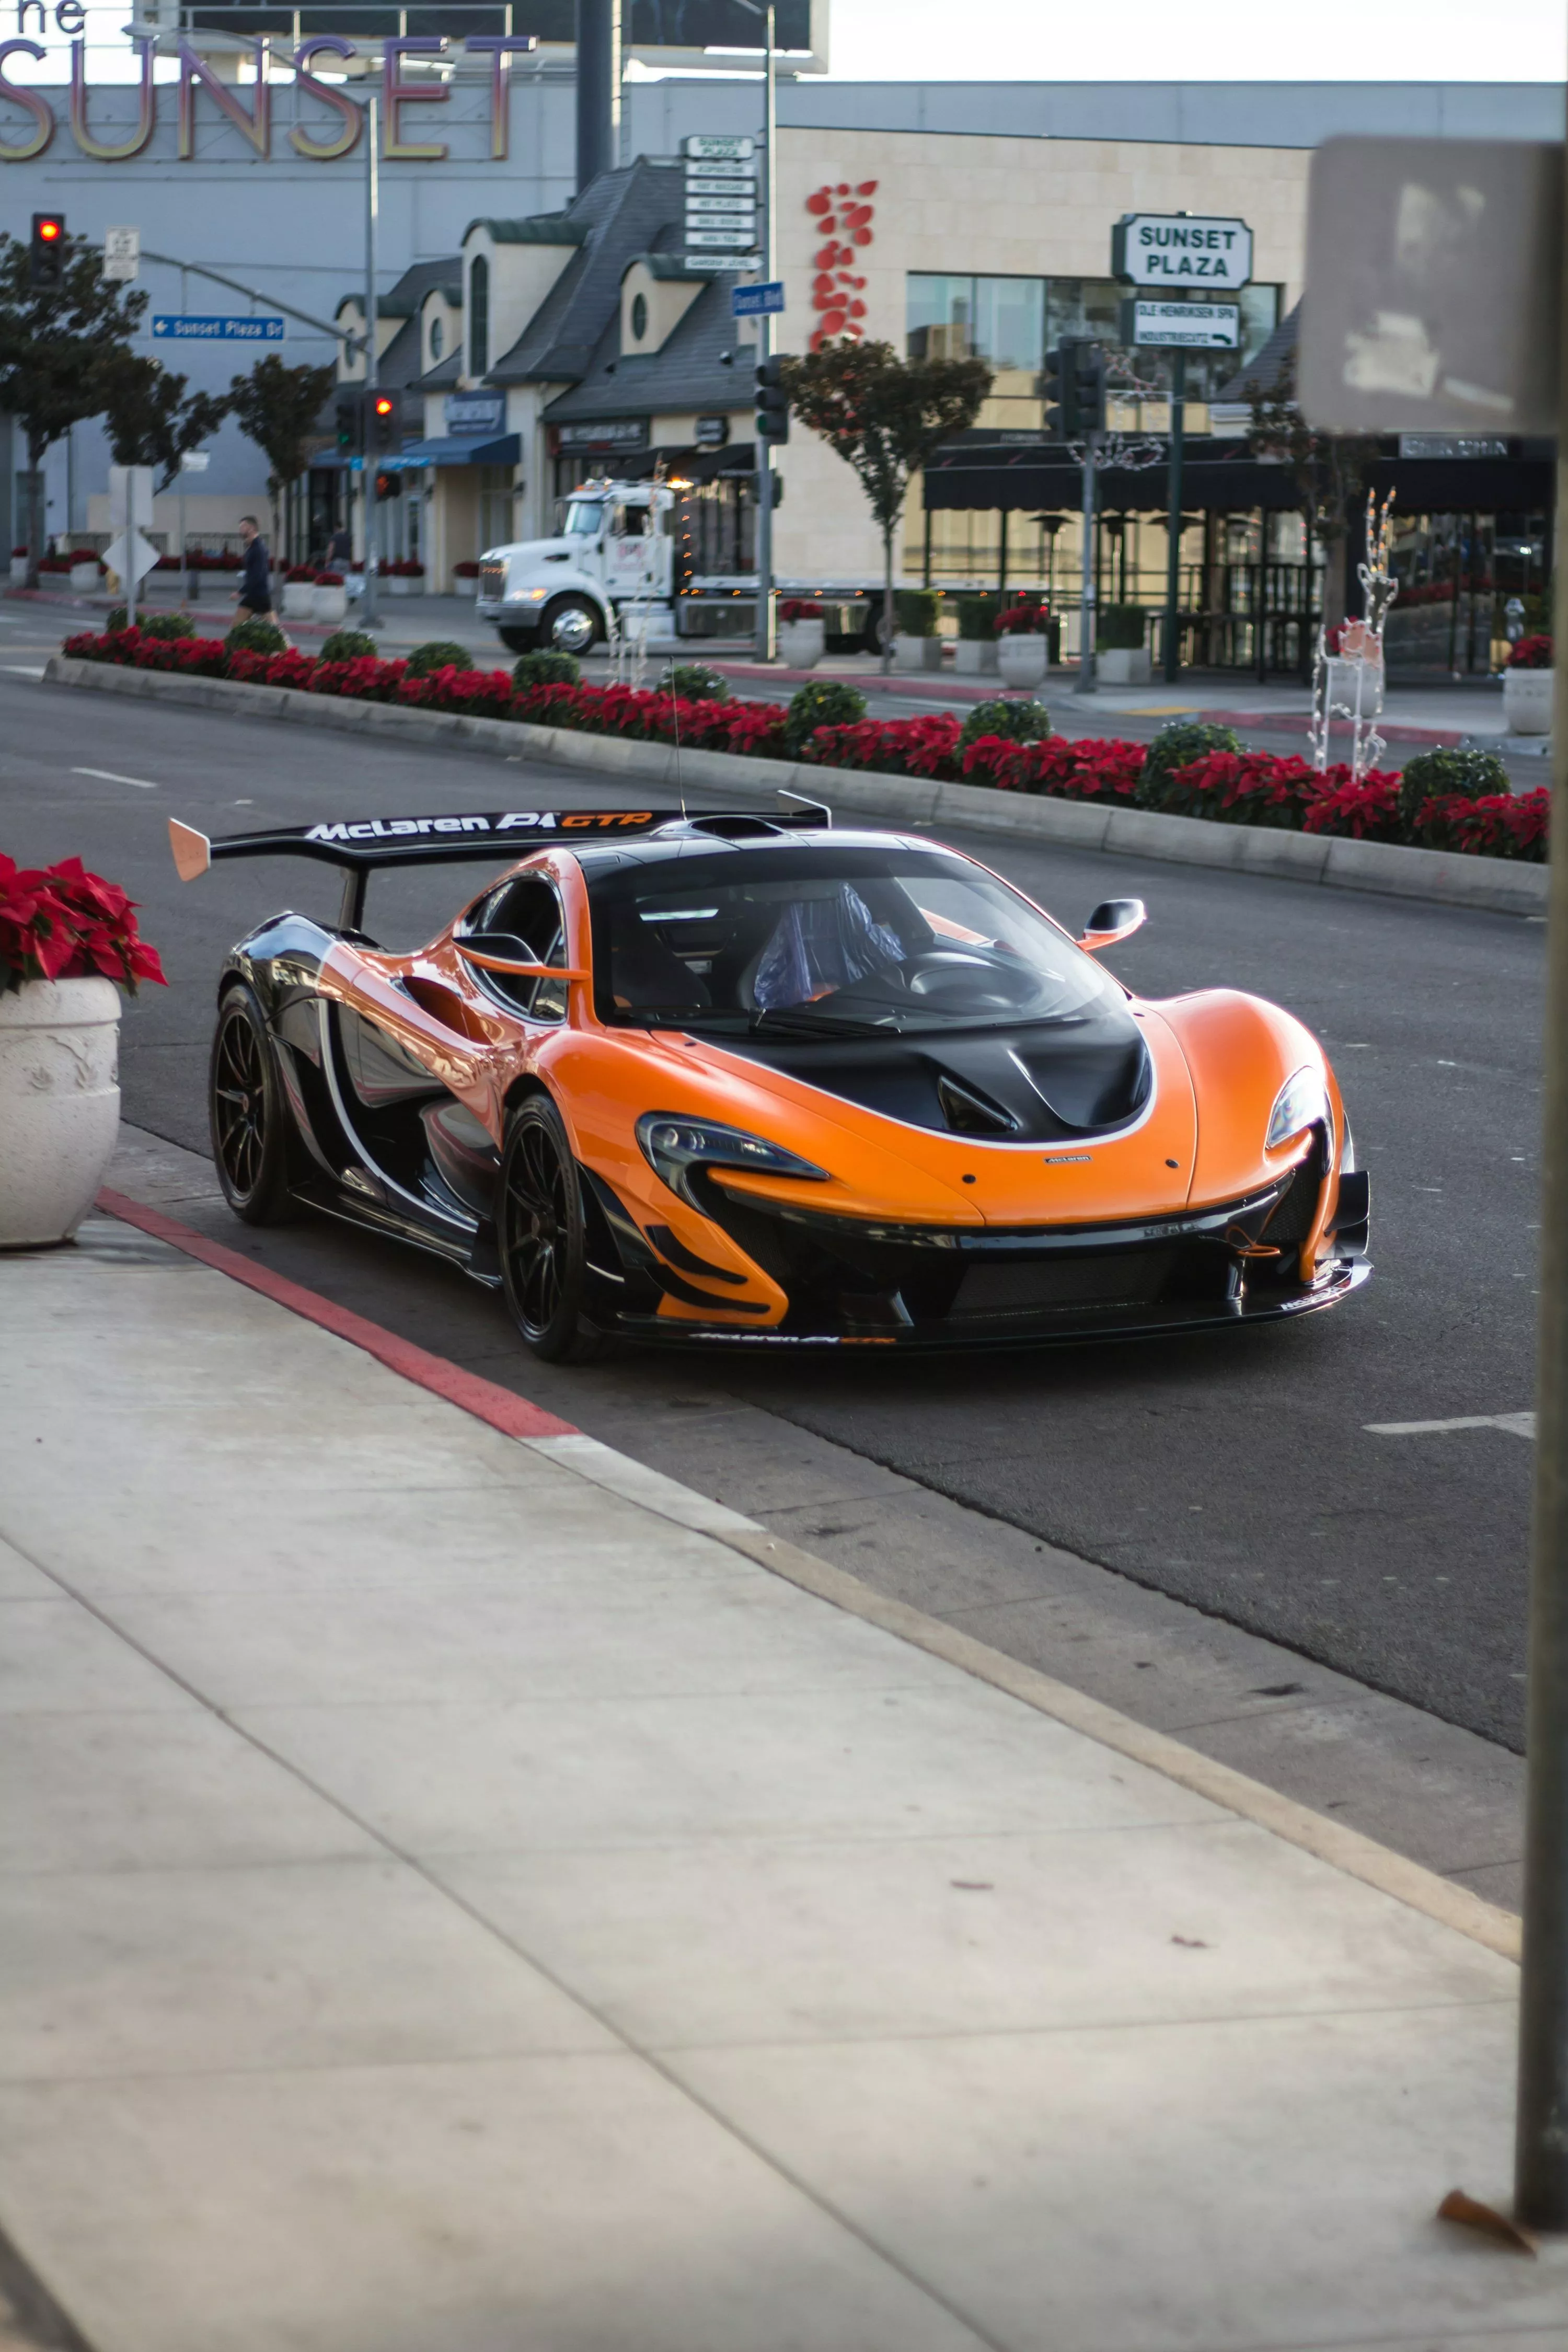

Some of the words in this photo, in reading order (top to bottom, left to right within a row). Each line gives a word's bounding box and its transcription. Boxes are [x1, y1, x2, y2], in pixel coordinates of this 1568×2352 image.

[0, 37, 537, 159] SUNSET
[1139, 227, 1236, 249] SUNSET
[1147, 255, 1229, 276] PLAZA
[174, 320, 221, 336] Sunset
[225, 320, 262, 337] Plaza
[267, 321, 283, 337] Dr
[305, 817, 490, 840] McLaren
[561, 812, 653, 827] GTR
[688, 1333, 799, 1342] McLaren
